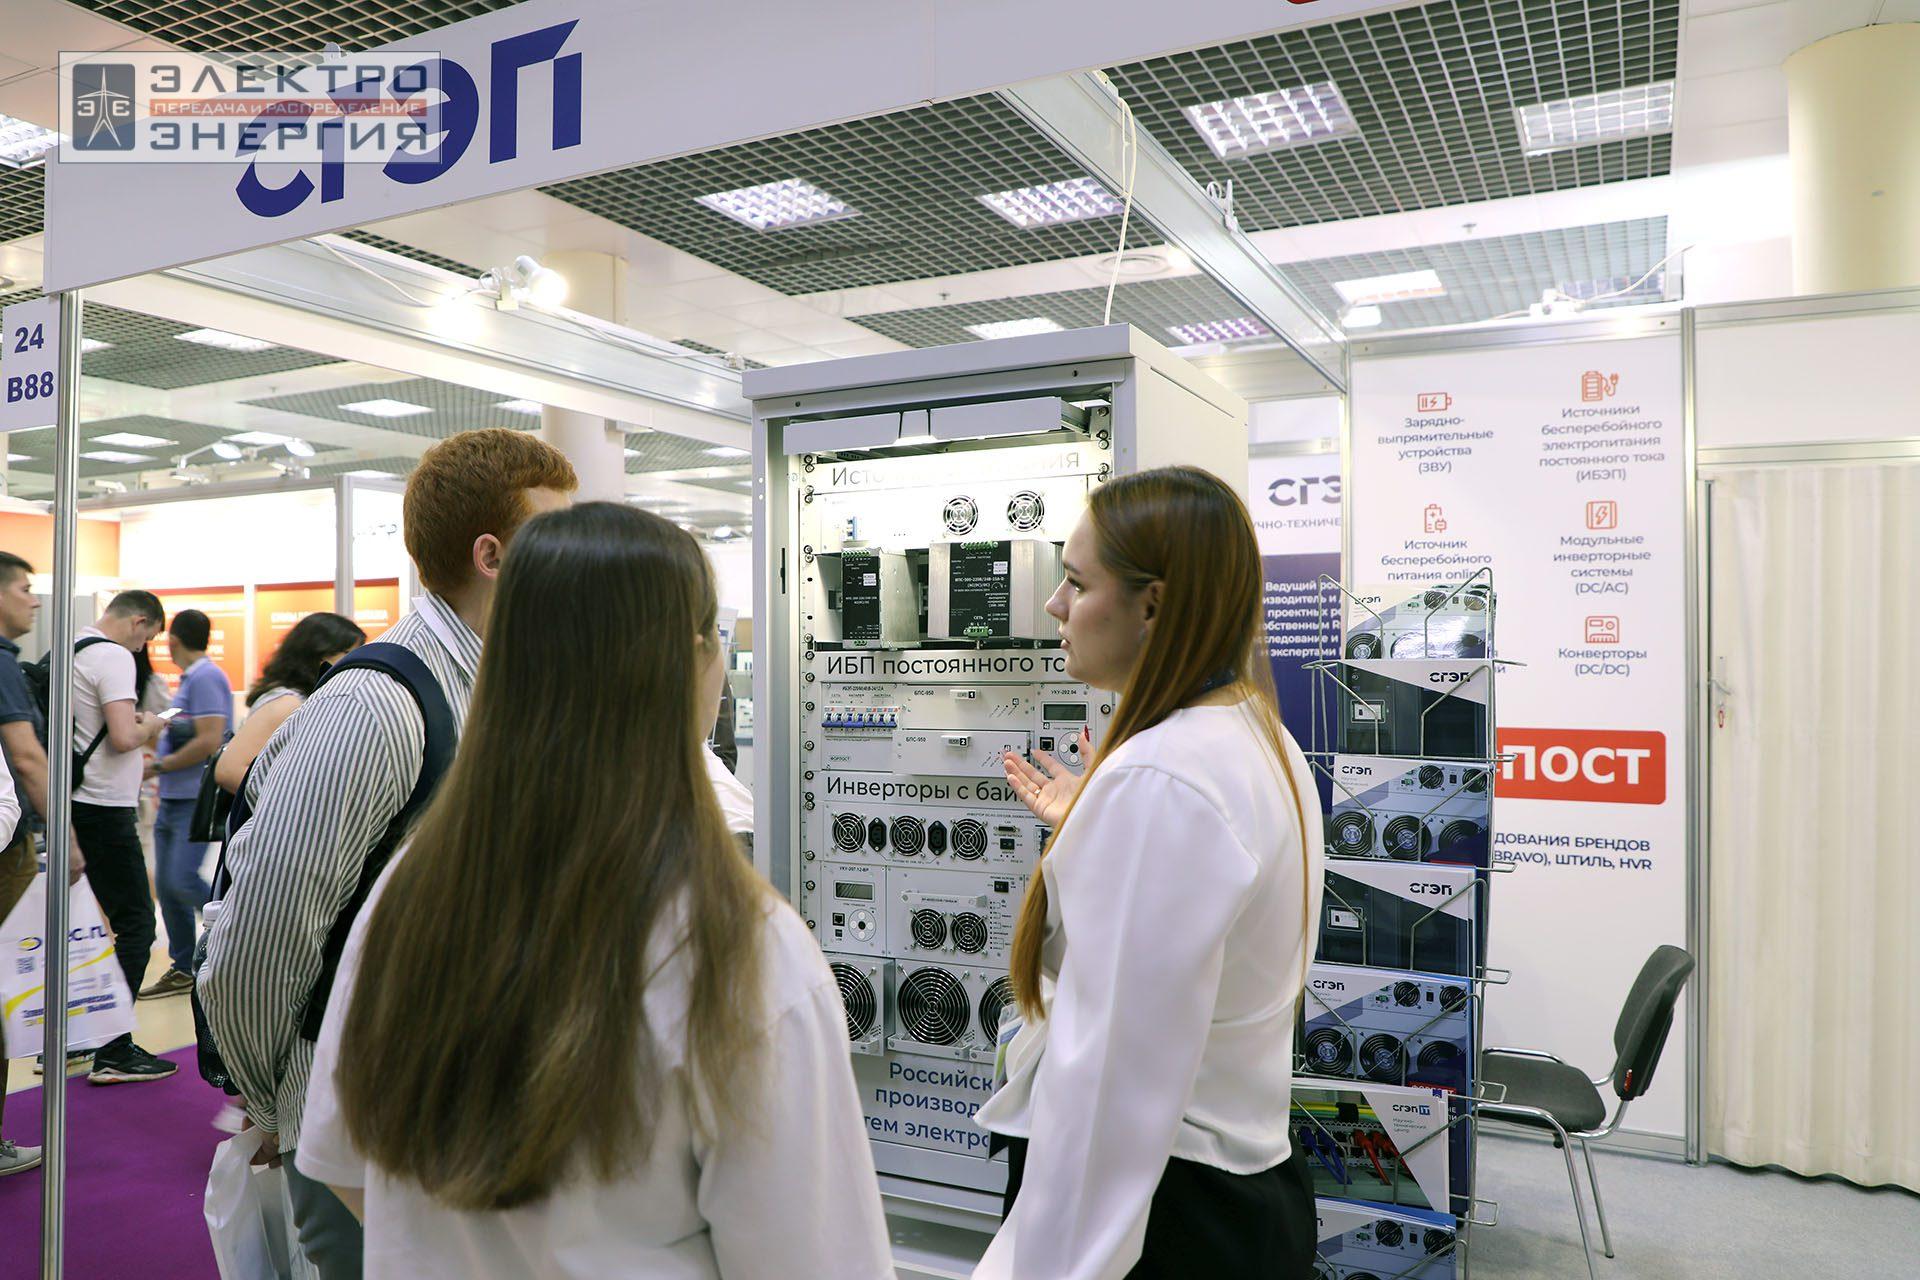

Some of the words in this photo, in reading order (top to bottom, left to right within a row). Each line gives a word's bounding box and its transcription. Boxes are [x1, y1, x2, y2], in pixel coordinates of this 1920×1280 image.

[14, 324, 45, 354] 24
[7, 371, 54, 402] B88
[1562, 405, 1640, 420] Источники
[1404, 415, 1465, 430] Зарядно-
[1541, 419, 1662, 436] бесперебойного
[1378, 430, 1493, 445] выпрямительные
[1542, 435, 1661, 452] электропитания
[1398, 446, 1472, 461] устройства
[1539, 454, 1629, 468] постоянного
[1634, 452, 1665, 463] тока
[1418, 461, 1452, 475] (ЗВУ)
[1576, 469, 1626, 482] (ИБЭП)
[1404, 539, 1467, 551] Источник
[1560, 534, 1644, 548] Модульные
[1381, 553, 1492, 568] бесперебойного
[1553, 550, 1651, 565] инверторные
[1387, 569, 1442, 581] питания
[1446, 568, 1485, 581] online
[1571, 567, 1633, 578] системы
[1265, 581, 1317, 593] Ведущий
[1575, 581, 1629, 595] (DC/AC)
[1559, 648, 1647, 661] Конверторы
[827, 656, 876, 675] ИБП
[882, 656, 1034, 675] постоянного
[1041, 656, 1066, 672] то
[1574, 663, 1630, 677] (DC/DC)
[1502, 744, 1651, 785] ПОСТ
[827, 776, 950, 801] Инверторы
[957, 785, 969, 800] с
[976, 780, 1017, 802] бай
[1494, 832, 1570, 847] ДОВАНИЯ
[1574, 836, 1651, 851] БРЕНДОВ
[1494, 851, 1551, 867] BRAVO),
[1555, 854, 1615, 869] ШТИЛЬ,
[1619, 858, 1652, 870] HVR
[889, 1062, 993, 1092] Российск
[875, 1088, 981, 1118] производ
[864, 1115, 898, 1134] тем
[904, 1121, 989, 1150] электро
